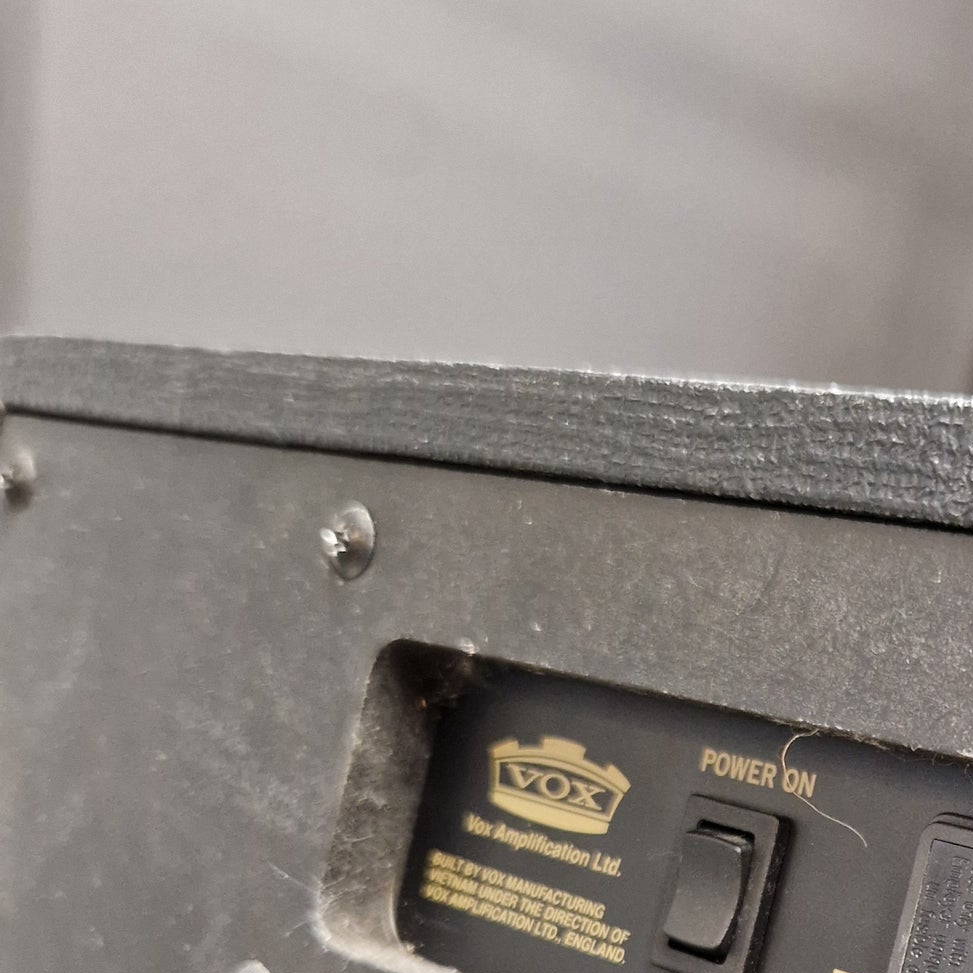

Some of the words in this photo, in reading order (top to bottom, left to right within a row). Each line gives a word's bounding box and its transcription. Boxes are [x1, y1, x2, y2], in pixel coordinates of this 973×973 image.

[505, 763, 606, 812] VOX
[700, 748, 777, 788] POWER
[781, 767, 817, 799] ON
[464, 812, 493, 837] Vox
[493, 824, 591, 868] Amplification
[591, 853, 622, 877] Ltd.
[423, 884, 449, 903] VOX
[448, 891, 535, 933] AMPLIFICATION
[427, 868, 478, 896] VIETNAM
[478, 882, 519, 909] UNDER
[520, 896, 543, 918] THE
[544, 903, 610, 939] DIRECTION
[611, 928, 631, 945] OF
[428, 850, 463, 871] BUILT
[464, 859, 482, 877] BY
[482, 866, 506, 887] VOX
[506, 875, 606, 919] MANUFACTURING
